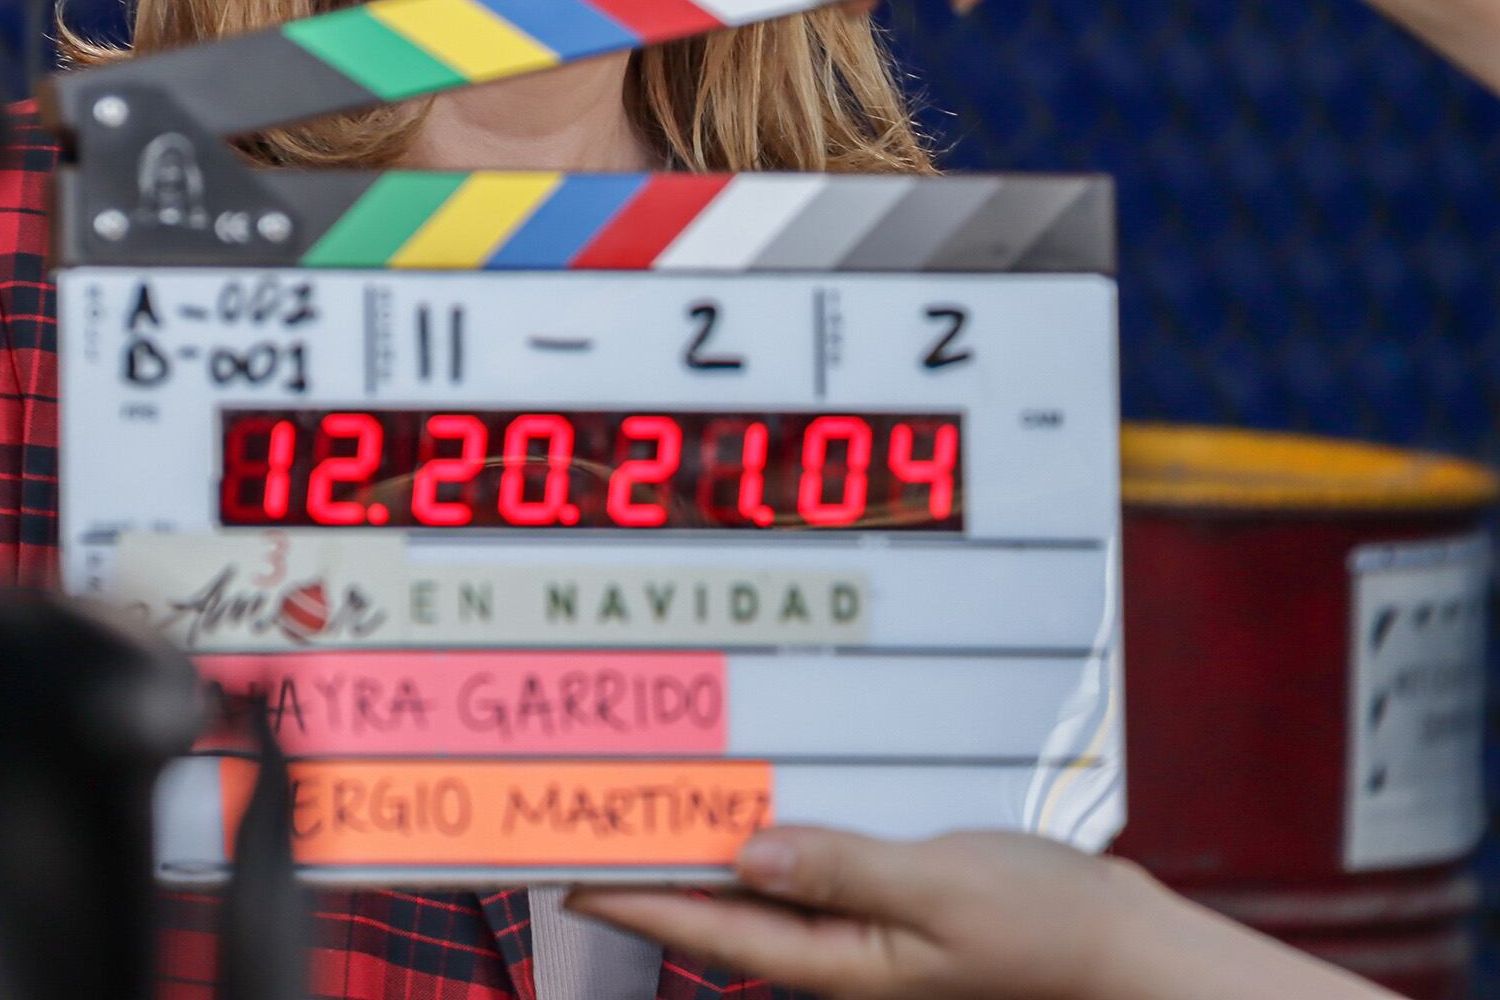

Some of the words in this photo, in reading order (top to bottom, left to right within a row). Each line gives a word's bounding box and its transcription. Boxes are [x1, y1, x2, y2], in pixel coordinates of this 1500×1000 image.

[684, 302, 744, 371] 2
[922, 307, 974, 369] 2
[411, 579, 492, 626] EN
[545, 580, 863, 625] NAVIDAD
[208, 672, 430, 739] AYRA
[455, 667, 724, 742] GARRIDO
[272, 775, 473, 840] ERGIO
